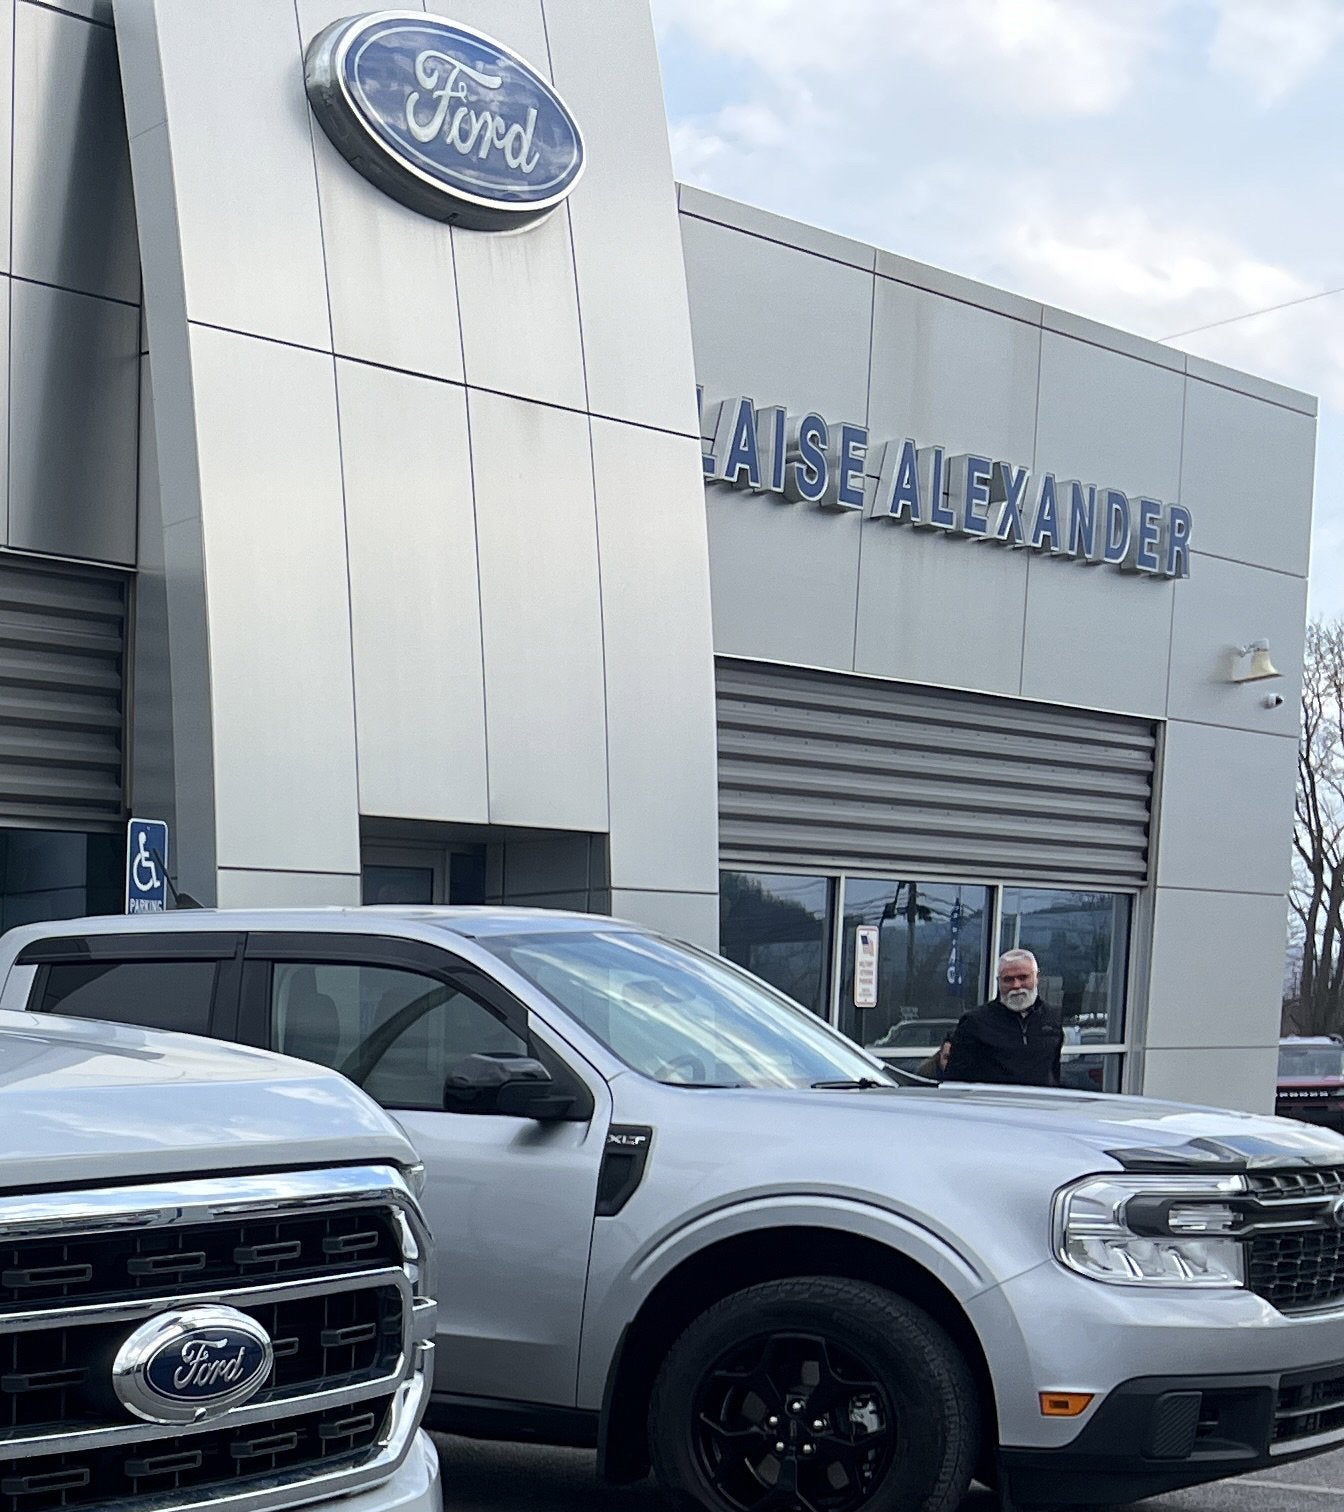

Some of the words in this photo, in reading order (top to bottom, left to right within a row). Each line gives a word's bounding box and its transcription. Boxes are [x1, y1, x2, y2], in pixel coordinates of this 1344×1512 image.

[405, 49, 540, 175] Ford
[884, 436, 1194, 579] ALEXANDER
[129, 898, 163, 914] PARKING
[608, 1134, 646, 1145] XLT
[173, 1338, 246, 1390] Ford
